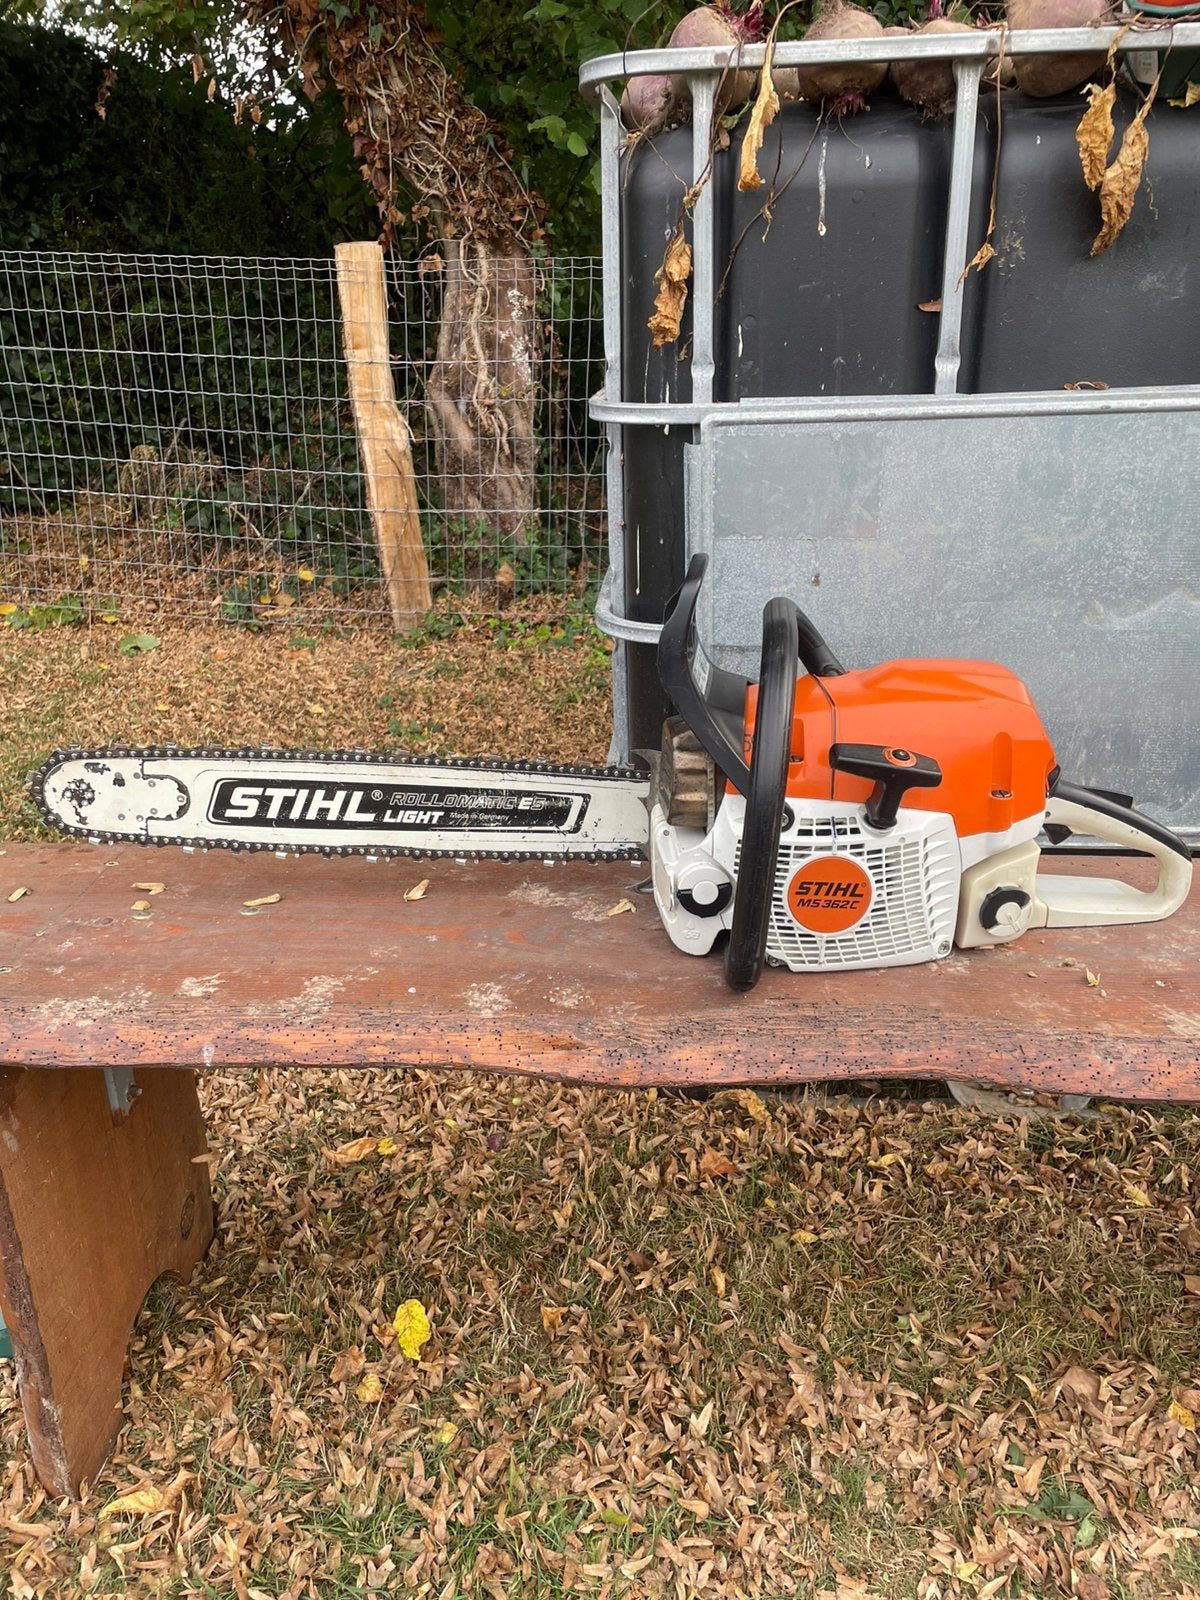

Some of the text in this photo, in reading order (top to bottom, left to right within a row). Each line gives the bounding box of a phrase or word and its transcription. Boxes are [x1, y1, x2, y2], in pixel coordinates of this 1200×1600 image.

[389, 791, 517, 811] ROLLOMATIC
[383, 810, 445, 824] LIGHT
[449, 812, 468, 821] Made
[479, 813, 510, 823] Germany
